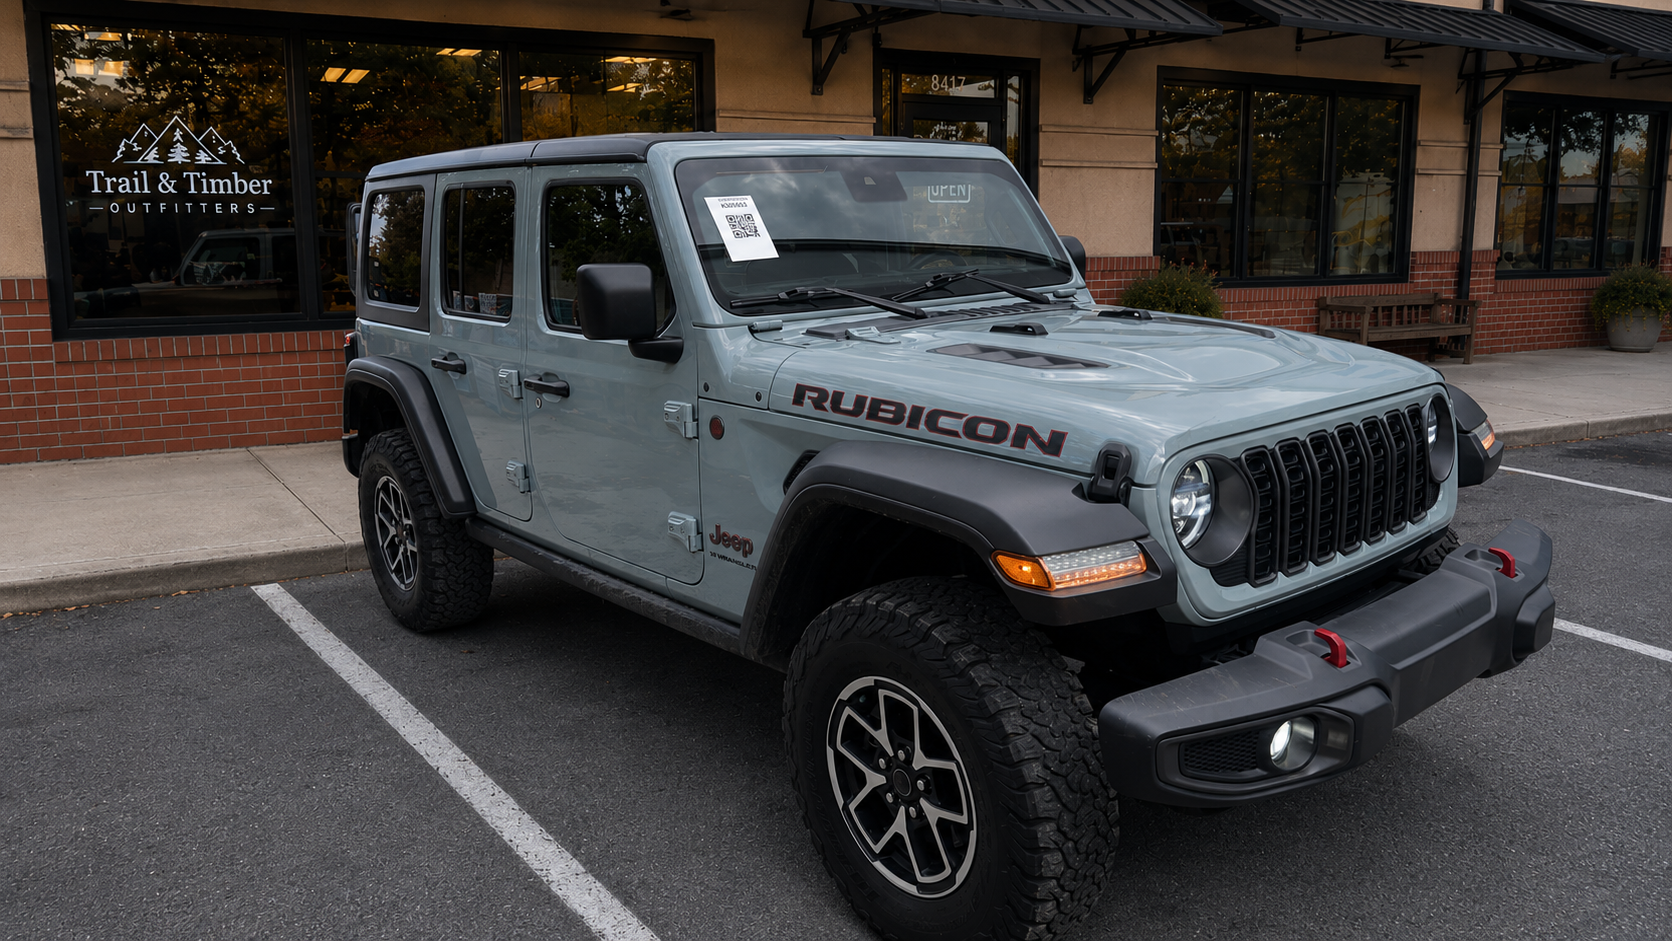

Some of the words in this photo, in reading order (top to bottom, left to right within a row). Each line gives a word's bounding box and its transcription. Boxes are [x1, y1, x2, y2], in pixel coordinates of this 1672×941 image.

[931, 74, 966, 92] 8417
[85, 170, 151, 194] Trail
[158, 172, 178, 194] &
[183, 171, 273, 195] Timber
[931, 184, 966, 197] OPEN
[110, 202, 255, 214] OUTFITTERS
[791, 383, 1069, 458] RUBICON
[709, 523, 754, 558] Jeep
